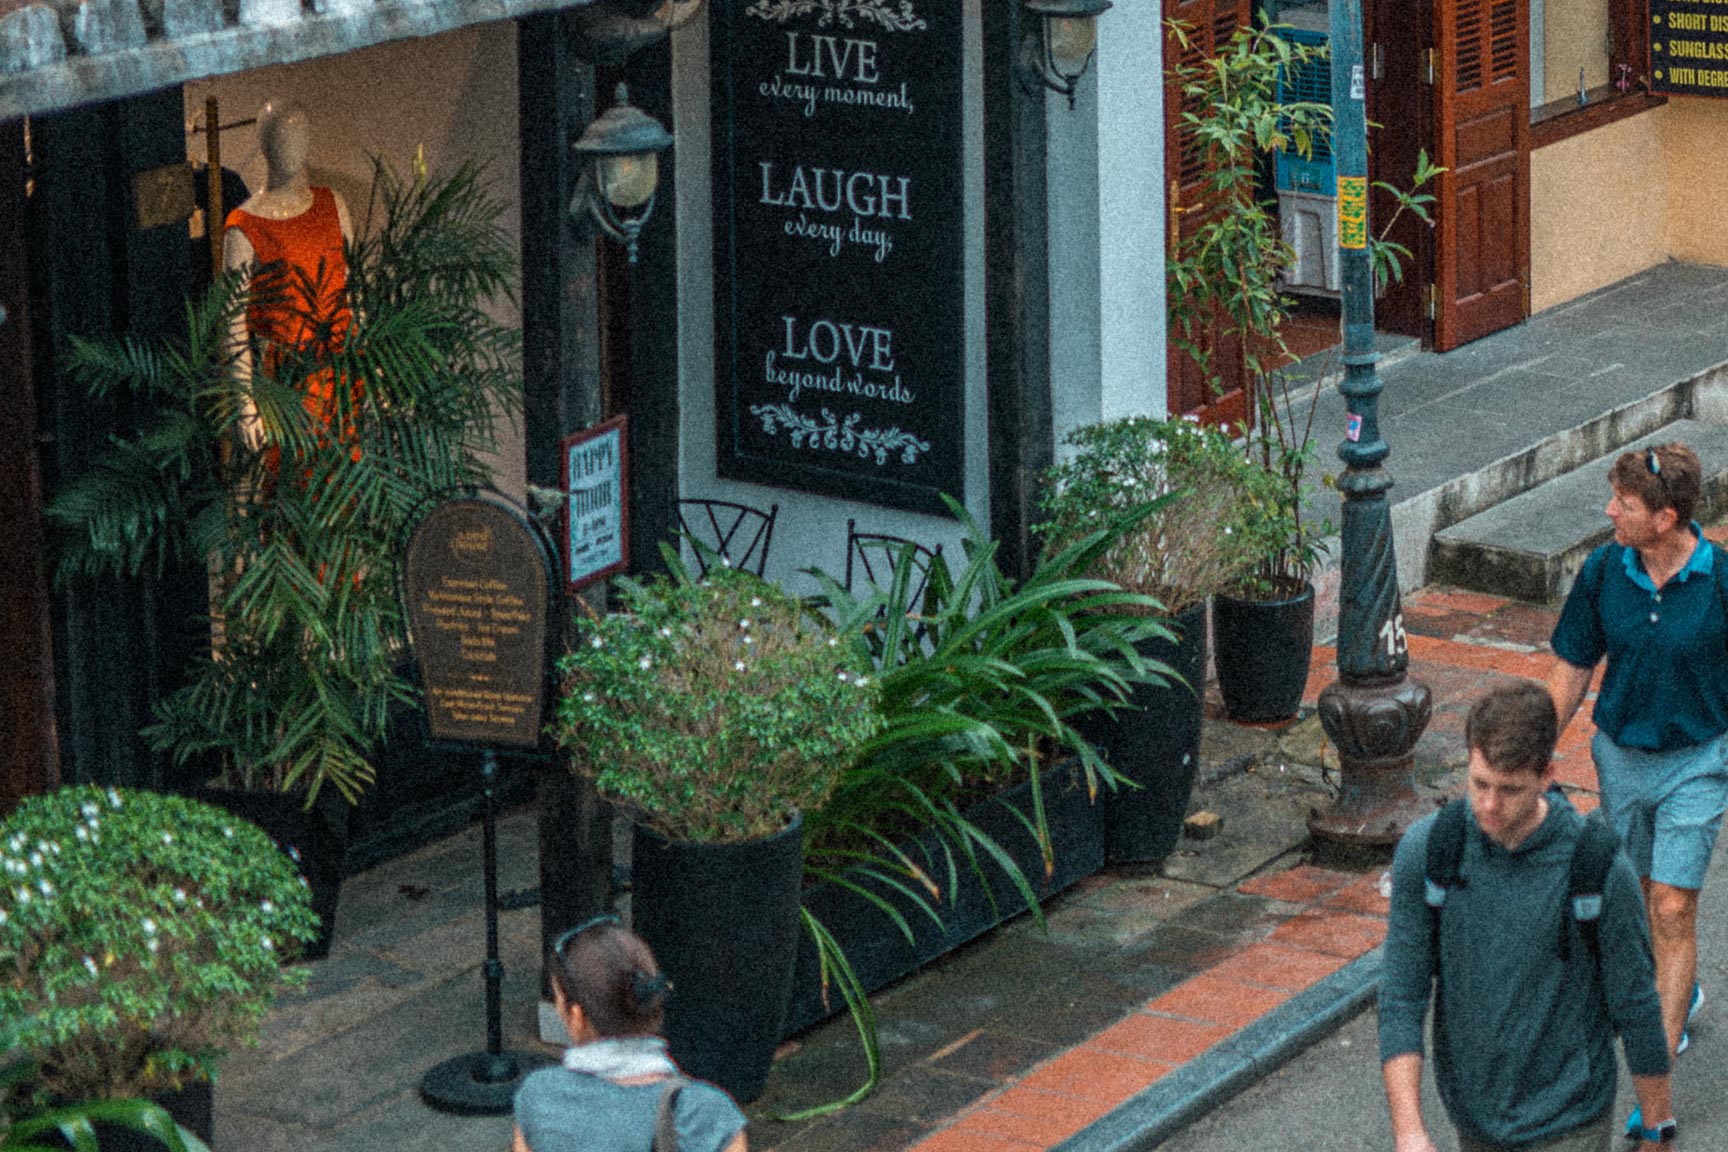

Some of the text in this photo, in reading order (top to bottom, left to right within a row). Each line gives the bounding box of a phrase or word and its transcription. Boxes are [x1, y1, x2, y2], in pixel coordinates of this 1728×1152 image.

[1668, 12, 1707, 32] SHORT
[785, 32, 880, 84] LIVE
[1669, 68, 1696, 86] WITH
[760, 78, 821, 117] every
[758, 161, 911, 221] LAUGH
[784, 217, 844, 258] every
[782, 317, 894, 372] LOVE
[765, 350, 916, 404] beyond words
